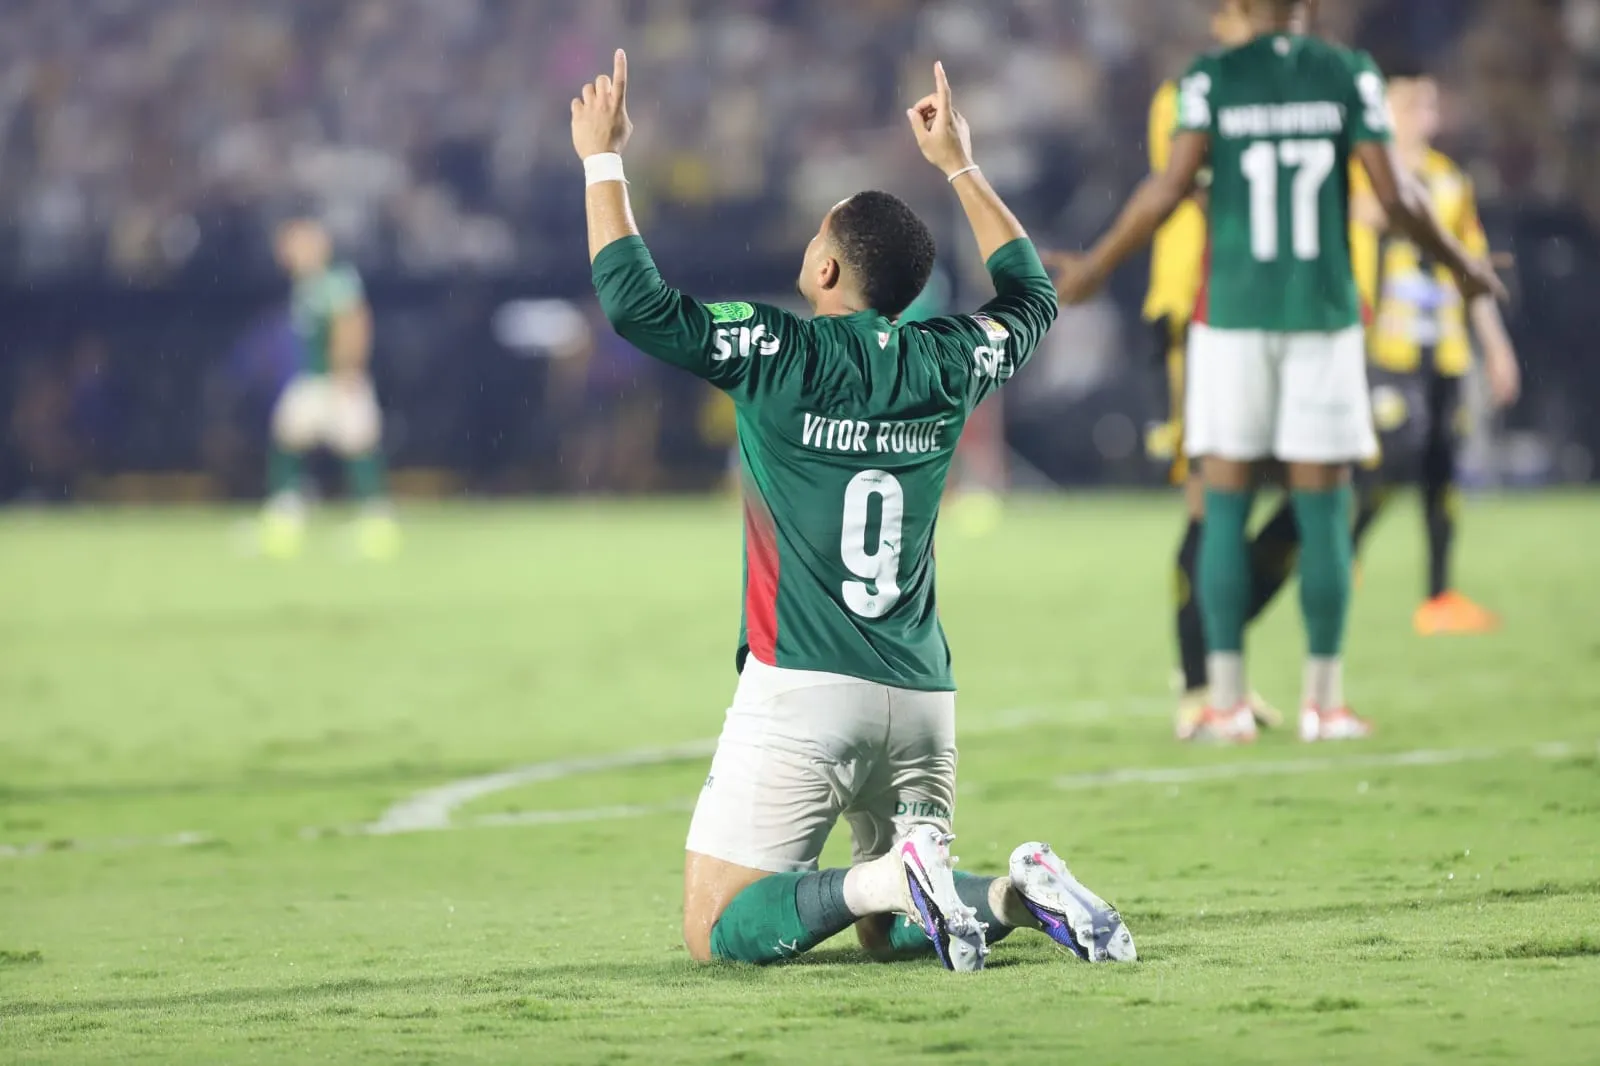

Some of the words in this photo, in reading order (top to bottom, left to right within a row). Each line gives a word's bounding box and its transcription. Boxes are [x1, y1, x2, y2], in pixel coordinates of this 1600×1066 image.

[1240, 139, 1336, 261] 17
[802, 413, 870, 451] VITOR
[876, 420, 945, 453] ROQUE
[841, 469, 904, 618] 9
